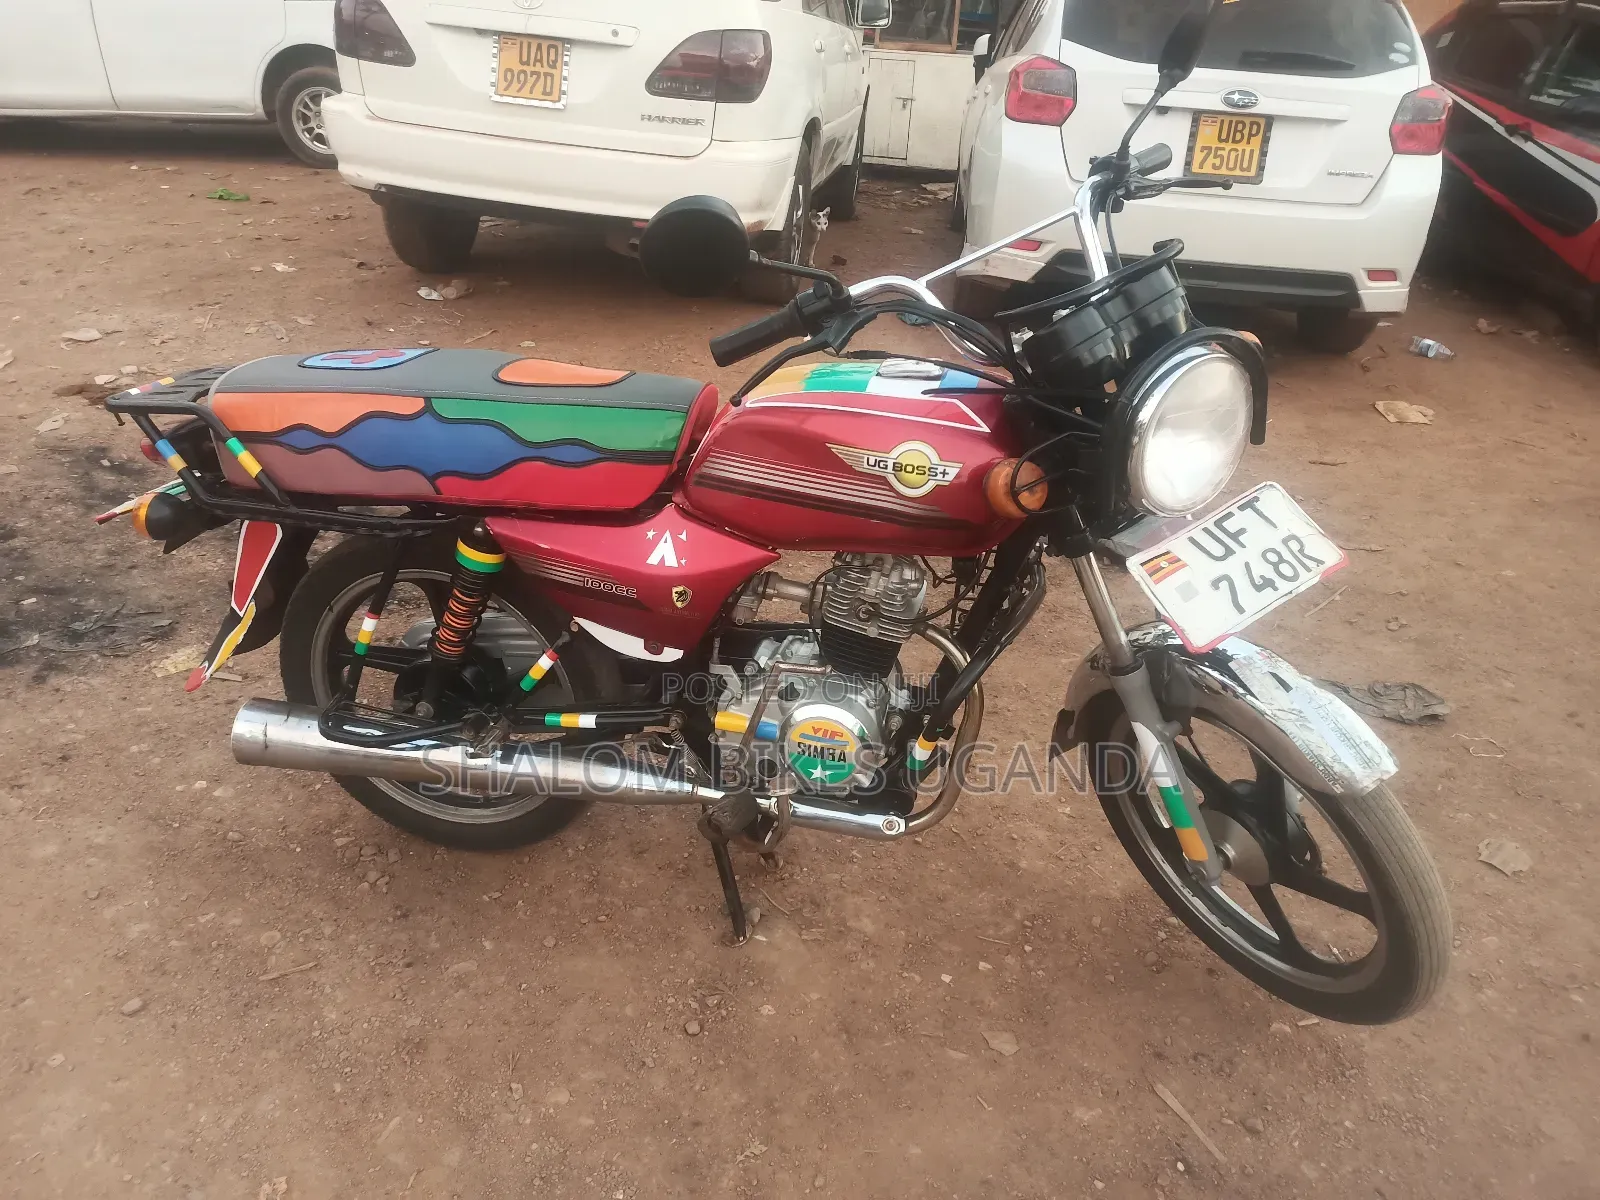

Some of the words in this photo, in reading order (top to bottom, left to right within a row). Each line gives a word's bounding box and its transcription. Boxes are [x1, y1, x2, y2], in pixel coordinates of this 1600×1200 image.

[518, 43, 559, 70] UAQ
[502, 67, 555, 97] 997D
[640, 113, 706, 127] HARRIER
[1217, 118, 1261, 145] UBP
[1198, 145, 1254, 172] 750U
[866, 456, 889, 471] UG
[1187, 495, 1279, 562] UFT
[1210, 534, 1326, 615] 748R
[811, 725, 844, 740] VIP
[797, 741, 847, 763] SIMBA
